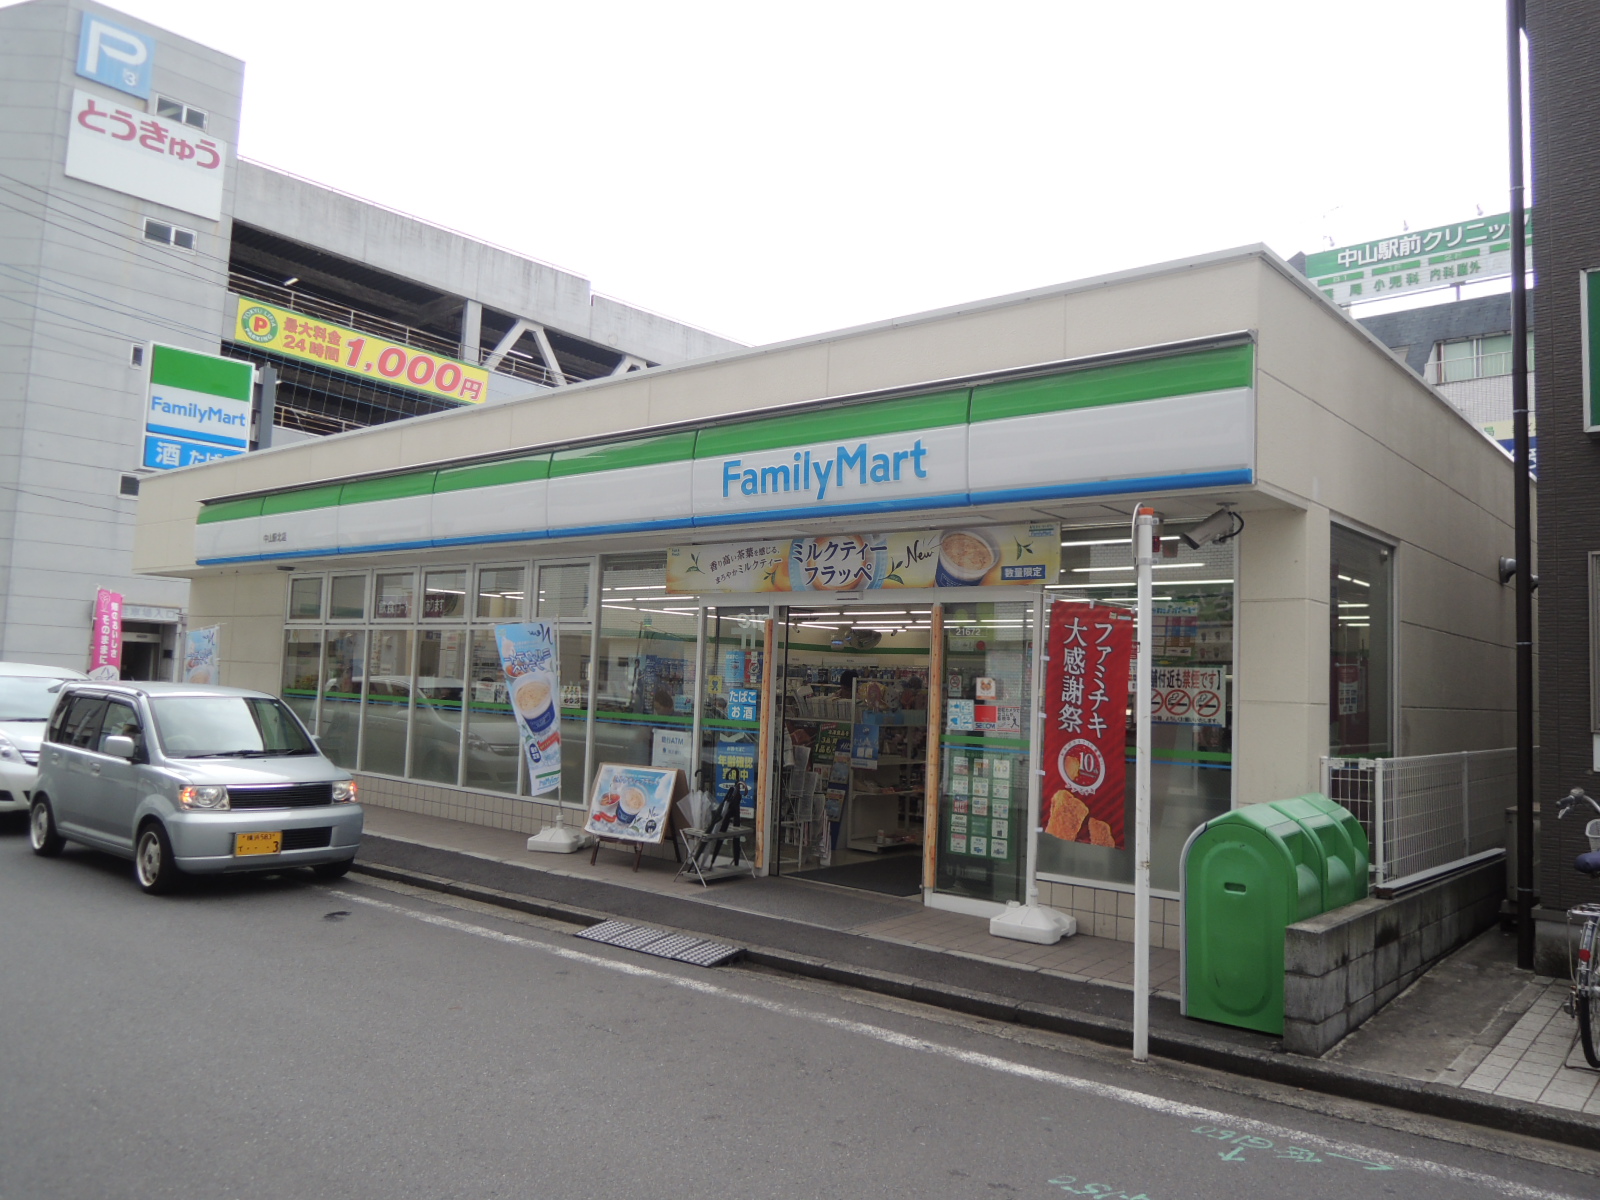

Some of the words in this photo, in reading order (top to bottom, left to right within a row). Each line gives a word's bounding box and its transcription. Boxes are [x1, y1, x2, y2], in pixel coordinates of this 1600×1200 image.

[86, 20, 147, 74] P
[125, 70, 137, 86] 3
[78, 99, 220, 169] とうきゅう
[1374, 272, 1420, 292] 小児科
[245, 328, 273, 342] PARKING
[253, 316, 268, 332] P
[284, 317, 342, 346] 最大料金
[283, 335, 340, 362] 24時間
[345, 336, 484, 400] 1,000円
[151, 396, 246, 426] FamilyMart
[155, 441, 181, 466] 酒
[722, 438, 927, 500] FamilyMart
[793, 541, 887, 563] ミルクティー
[905, 539, 934, 568] New
[715, 558, 782, 585] まろやかミルクティー
[804, 563, 873, 586] フラッペ
[1004, 567, 1042, 578] 数量限定
[99, 614, 111, 664] そのままに
[955, 628, 980, 636] 21672
[1058, 617, 1088, 734] 大感謝祭
[1087, 623, 1113, 738] ファミチキ
[730, 690, 757, 703] たばこ
[731, 706, 753, 719] お酒
